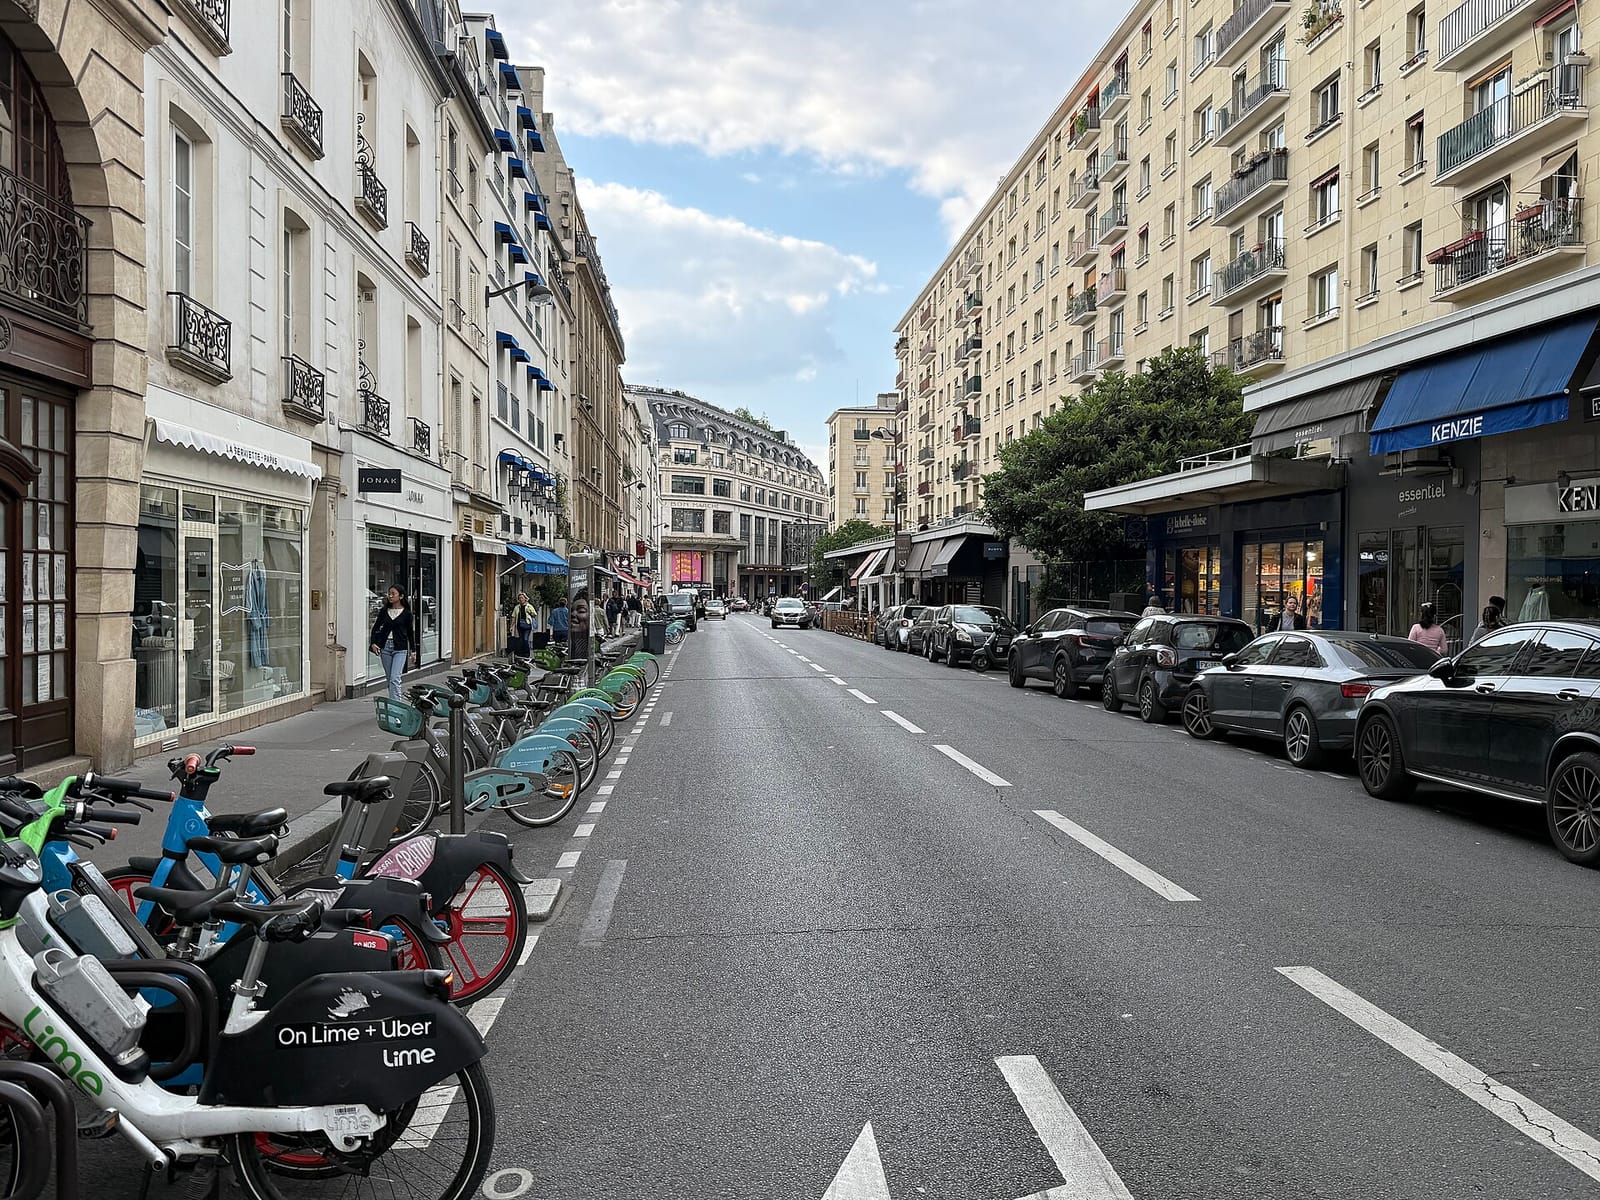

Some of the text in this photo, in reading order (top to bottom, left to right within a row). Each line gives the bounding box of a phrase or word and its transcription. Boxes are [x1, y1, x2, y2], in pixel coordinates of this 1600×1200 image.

[1295, 423, 1323, 438] essentiel
[1431, 416, 1484, 443] KENZIE
[1398, 479, 1446, 502] essentiel
[1558, 484, 1600, 513] KEN
[278, 1019, 432, 1045] On Lime + Uber
[23, 1006, 103, 1097] Lime
[383, 1047, 436, 1067] Lime
